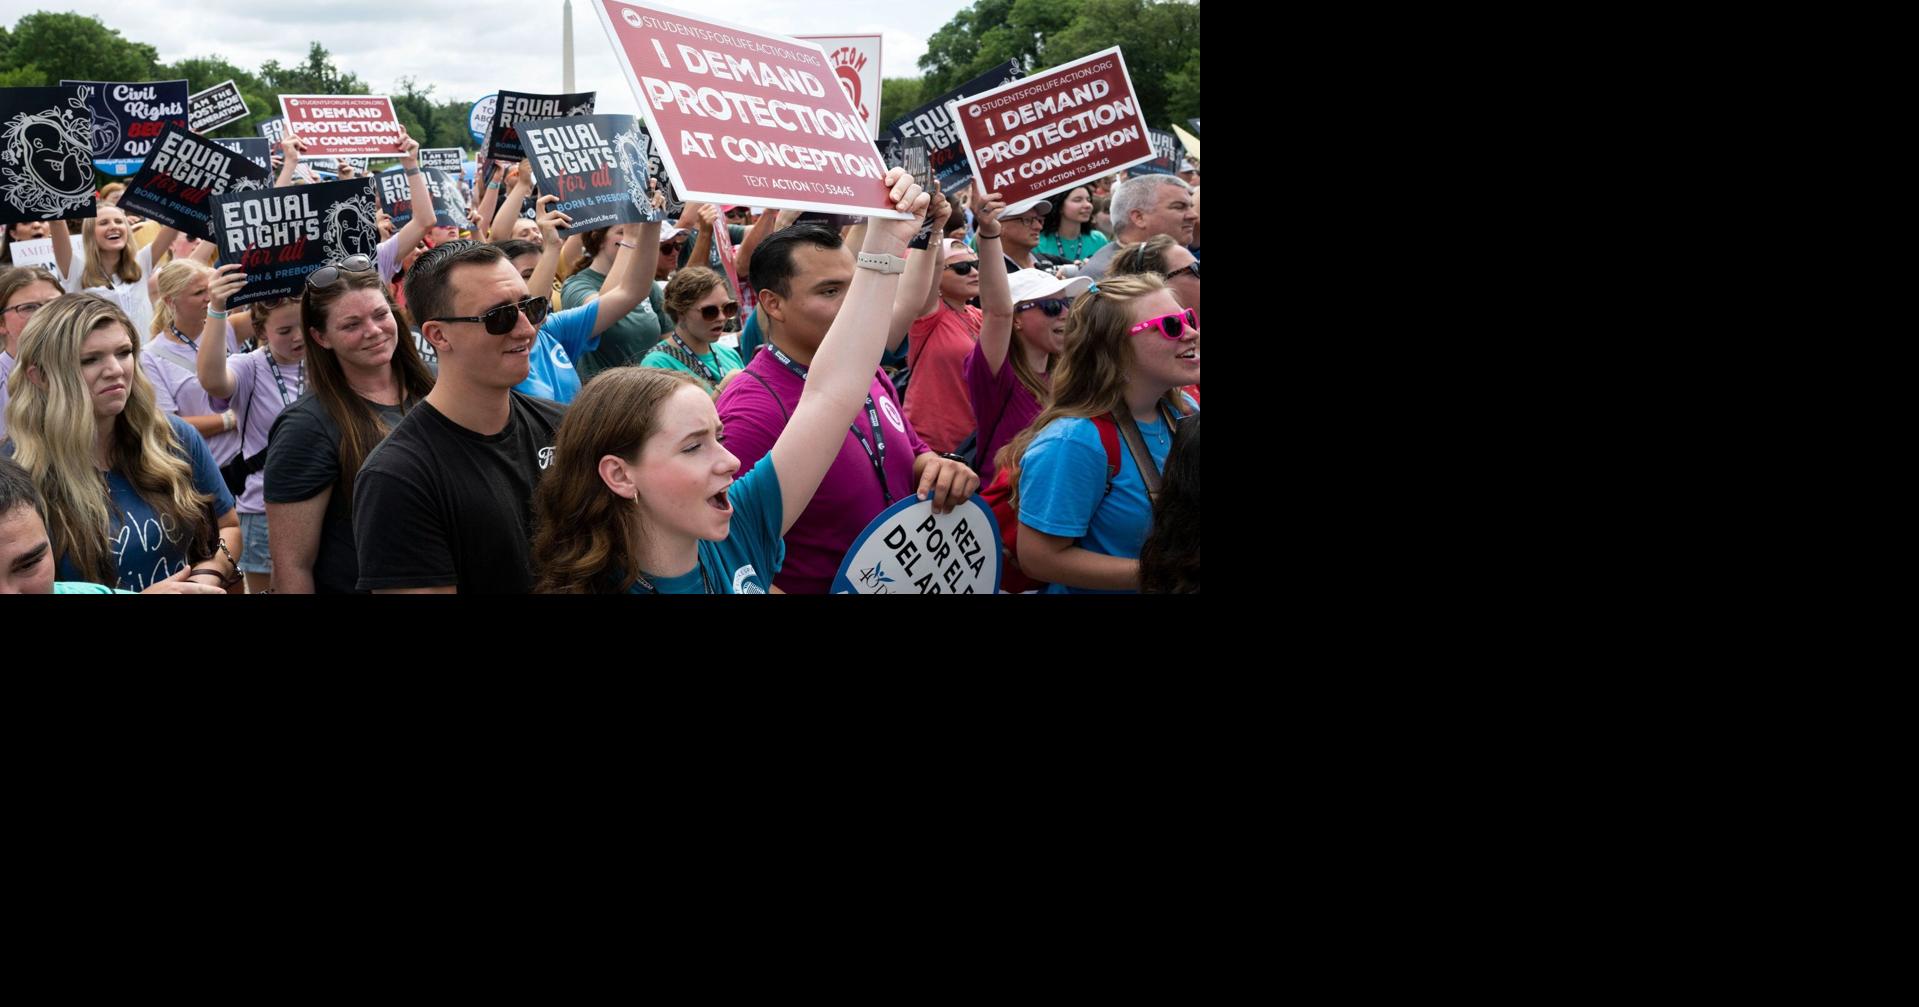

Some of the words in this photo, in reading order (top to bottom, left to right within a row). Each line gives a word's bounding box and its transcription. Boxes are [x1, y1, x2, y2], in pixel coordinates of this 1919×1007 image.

[651, 38, 671, 69] I
[677, 43, 825, 98] DEMAND
[113, 84, 157, 101] Civil
[193, 98, 210, 110] AM
[212, 88, 233, 101] THE
[981, 60, 1112, 112] STUDENTSFORLIFEACTION.ORG
[124, 101, 183, 121] Rights
[192, 103, 243, 129] GENERATION
[300, 107, 307, 118] I
[311, 107, 382, 119] DEMAND
[502, 96, 563, 116] EQUAL
[641, 76, 868, 144] PROTECTION
[984, 119, 995, 137] I
[1001, 79, 1109, 131] DEMAND
[292, 121, 398, 133] PROTECTION
[302, 136, 318, 145] AT
[320, 136, 400, 146] CONCEPTION
[526, 123, 608, 155] EQUAL
[975, 96, 1136, 169] PROTECTION
[1152, 132, 1175, 150] UAL
[160, 131, 231, 180] EQUAL
[537, 147, 618, 179] RIGHTS
[680, 130, 717, 159] AT
[721, 136, 884, 180] CONCEPTION
[992, 167, 1015, 190] AT
[1019, 125, 1139, 178] CONCEPTION
[150, 151, 229, 196] RIGHTS
[558, 168, 586, 201] for
[592, 163, 612, 188] all
[744, 175, 769, 189] TEXT
[772, 178, 810, 192] ACTION
[812, 181, 825, 194] TO
[826, 183, 854, 197] 53445
[1029, 180, 1047, 191] TEXT
[1048, 170, 1075, 185] ACTION
[1076, 165, 1087, 174] TO
[1087, 158, 1110, 171] 53445
[133, 186, 161, 201] BORN
[160, 198, 168, 206] &
[168, 200, 209, 221] PREBORN
[222, 193, 319, 229] EQUAL
[556, 198, 587, 212] BORN
[587, 197, 596, 206] &
[226, 218, 320, 253] RIGHTS
[240, 241, 272, 274] for
[279, 234, 308, 262] all
[246, 273, 262, 283] RN
[264, 272, 272, 280] &
[275, 263, 322, 279] PREBORN
[884, 524, 922, 578] DEL
[916, 514, 950, 567] POR
[943, 560, 964, 594] EL
[951, 518, 986, 579] REZA
